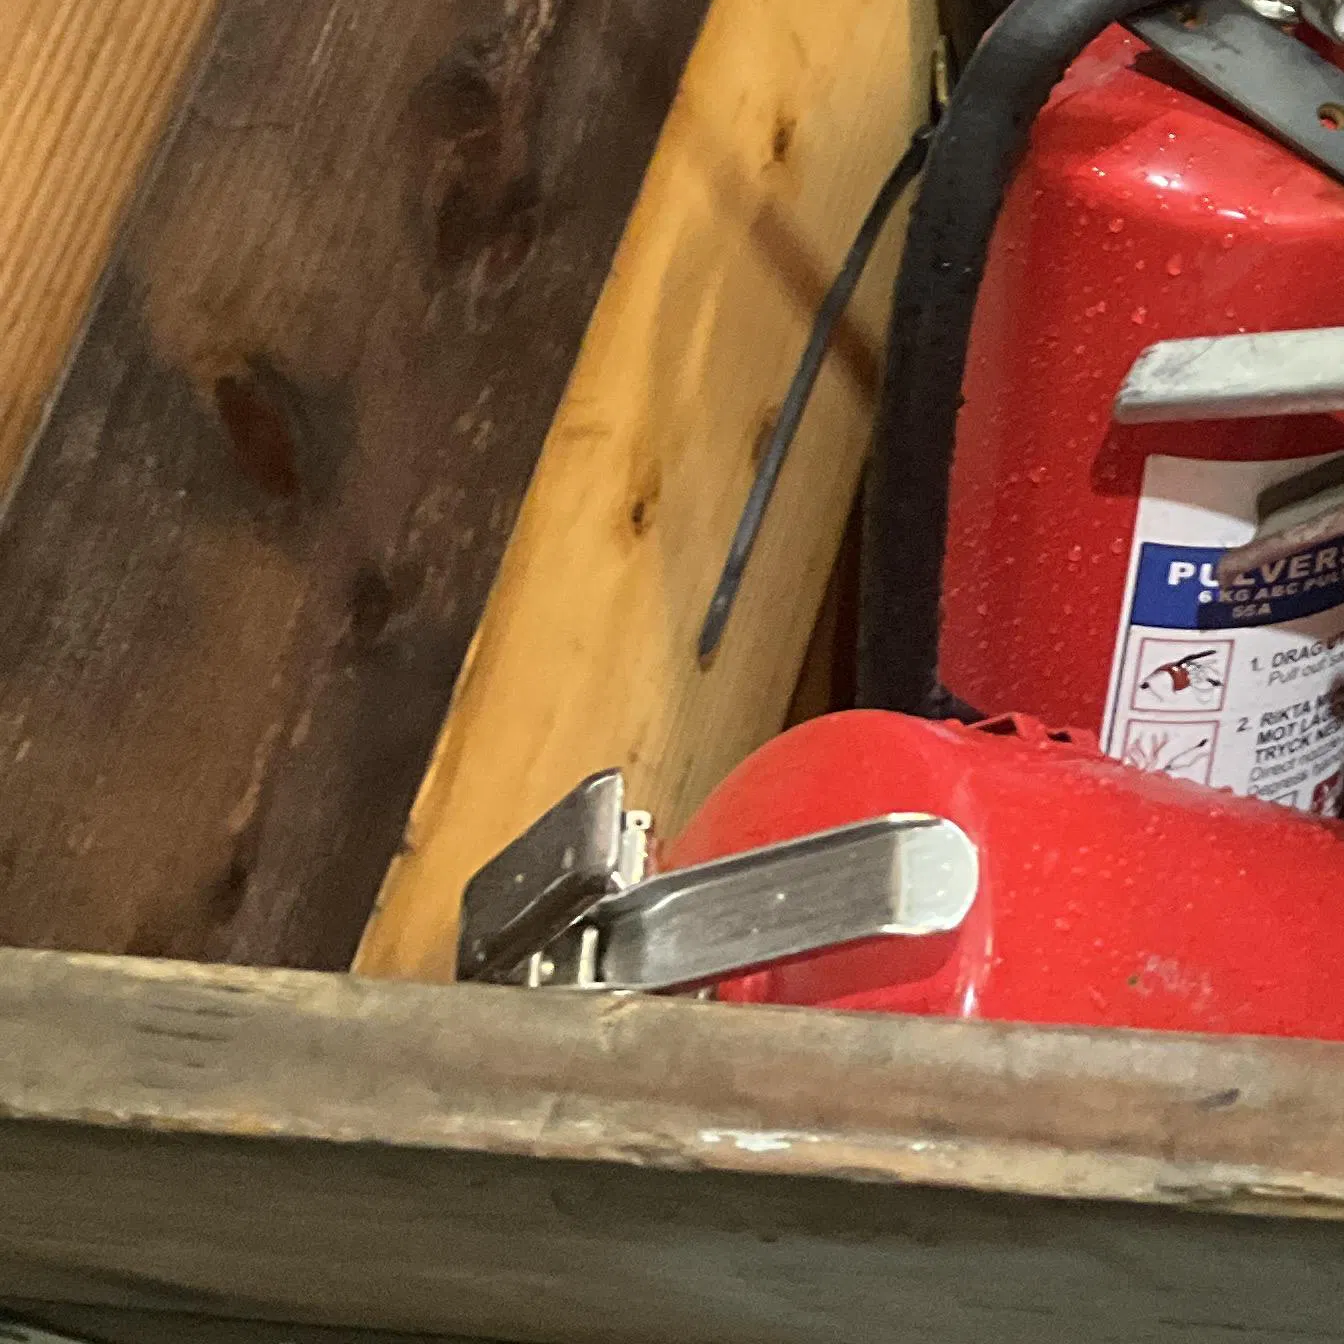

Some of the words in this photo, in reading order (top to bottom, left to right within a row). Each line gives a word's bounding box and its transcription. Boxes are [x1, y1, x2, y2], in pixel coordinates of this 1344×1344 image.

[1197, 590, 1213, 604] 6
[1218, 587, 1251, 603] KG
[1271, 640, 1323, 669] DRAG
[1256, 721, 1296, 746] MOT
[1255, 735, 1310, 763] TRYCK
